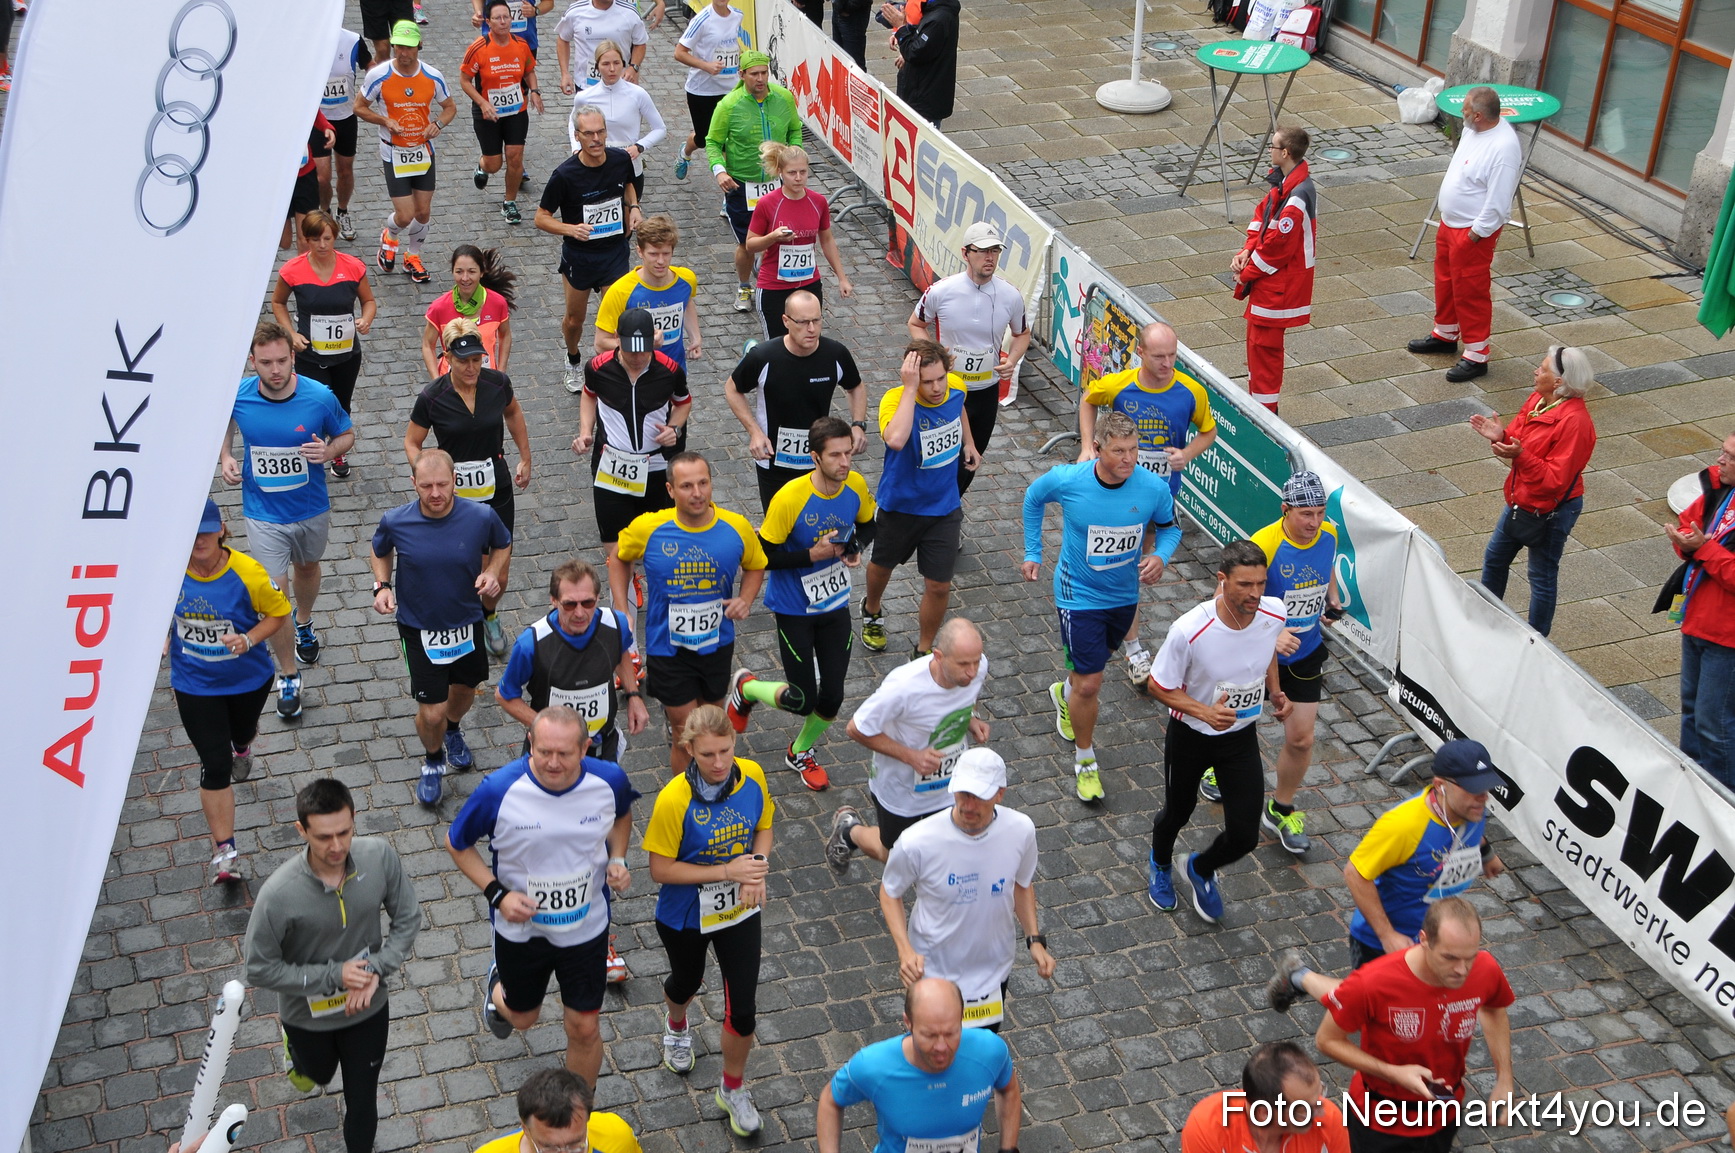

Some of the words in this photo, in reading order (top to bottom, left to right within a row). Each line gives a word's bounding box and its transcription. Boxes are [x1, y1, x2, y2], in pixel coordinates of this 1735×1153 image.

[490, 63, 520, 72] SportScheck
[716, 54, 738, 67] 2110
[492, 91, 520, 107] 2931
[831, 105, 850, 145] Braun
[400, 150, 423, 164] 629
[753, 182, 775, 198] 139
[587, 207, 619, 225] 2276
[593, 226, 613, 234] Werner
[783, 252, 813, 268] 2791
[325, 325, 343, 340] 16
[964, 357, 984, 372] 87
[962, 374, 982, 382] Ronny
[927, 429, 959, 457] 3335
[257, 456, 303, 475] 3386
[610, 459, 639, 480] 143
[455, 470, 486, 487] 610
[612, 477, 630, 489] Horst
[1190, 495, 1208, 522] Line:
[1208, 513, 1231, 544] 09181
[1093, 535, 1138, 554] 2240
[42, 564, 119, 789] Audi
[81, 318, 164, 520] BKK
[810, 571, 848, 602] 2184
[690, 605, 715, 614] Neumarkt
[1286, 595, 1322, 617] 2758
[675, 611, 719, 633] 2152
[427, 626, 469, 647] 2810
[1349, 622, 1373, 647] GmbH
[439, 648, 462, 658] Stefan
[551, 691, 573, 700] PARTL
[573, 691, 600, 700] Neumarkt
[528, 880, 551, 889] PARTL
[552, 877, 585, 888] Neumarkt
[700, 884, 722, 894] PARTL
[534, 882, 589, 911] 2887
[1541, 818, 1692, 967] stadtwerke
[543, 910, 583, 924] Christoph
[1395, 1023, 1418, 1033] NEU
